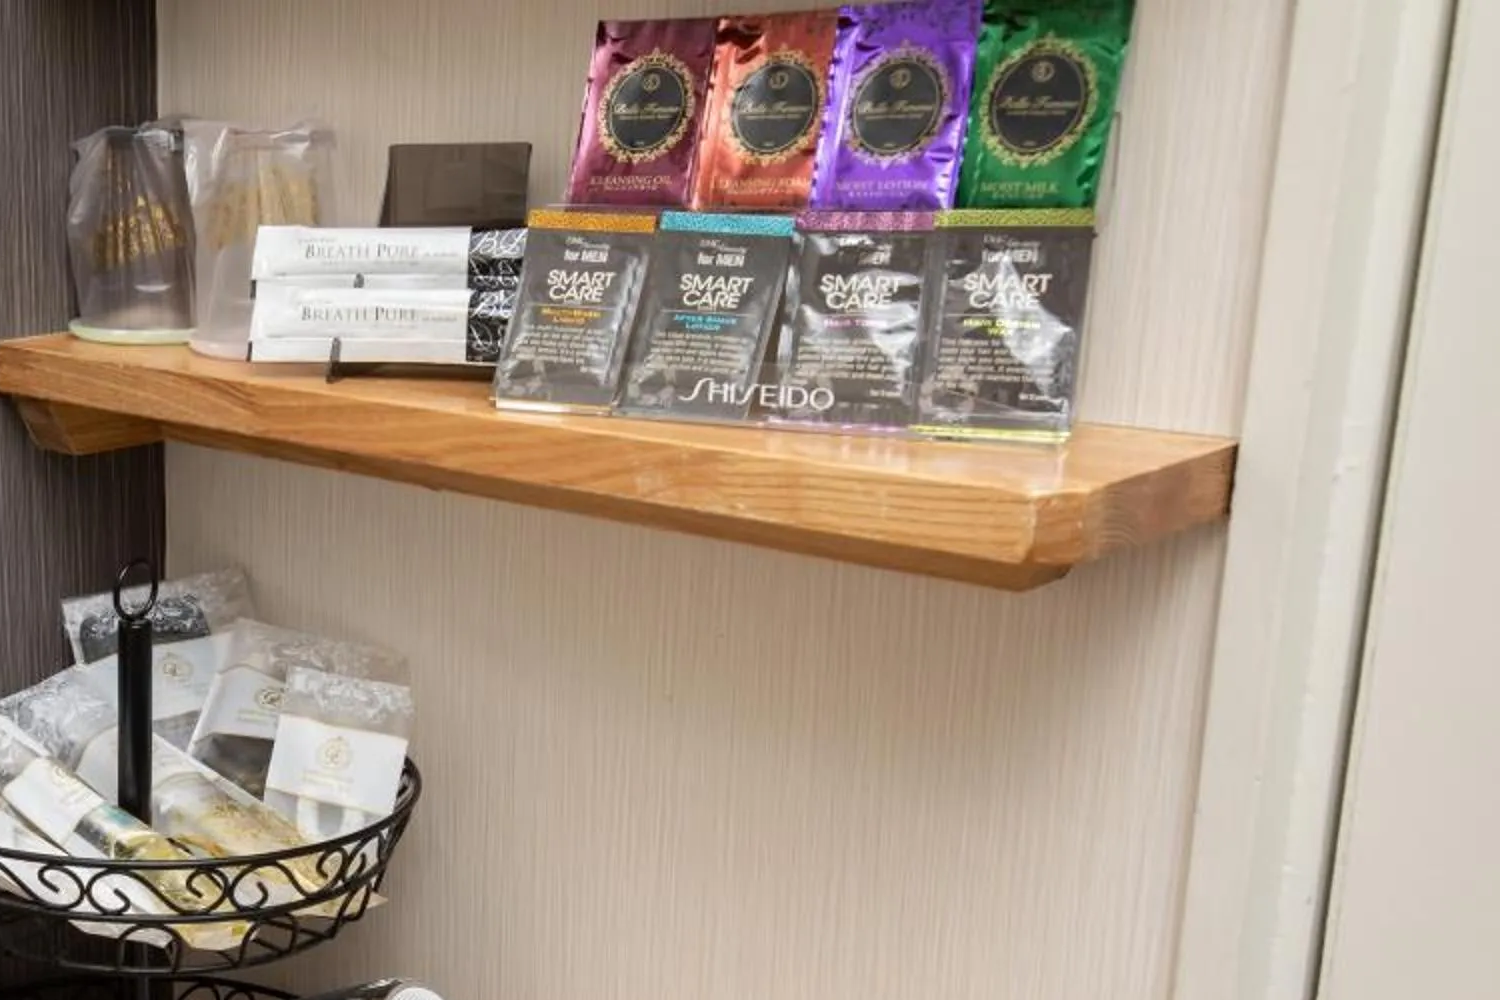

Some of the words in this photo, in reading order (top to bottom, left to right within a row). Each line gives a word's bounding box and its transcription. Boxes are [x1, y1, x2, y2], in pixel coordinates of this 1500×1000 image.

[304, 243, 370, 259] BREATH
[376, 243, 418, 259] PURE
[581, 250, 610, 264] MEN
[715, 253, 746, 268] MEN
[547, 268, 617, 290] SMART
[680, 273, 754, 295] SMART
[819, 273, 901, 294] SMART
[963, 273, 1053, 296] SMART
[549, 285, 605, 303] CARE
[683, 290, 742, 309] CARE
[825, 290, 894, 310] CARE
[969, 290, 1041, 310] CARE
[301, 305, 368, 321] BREATH
[375, 305, 418, 321] PURE
[678, 377, 835, 411] SHISEIDO
